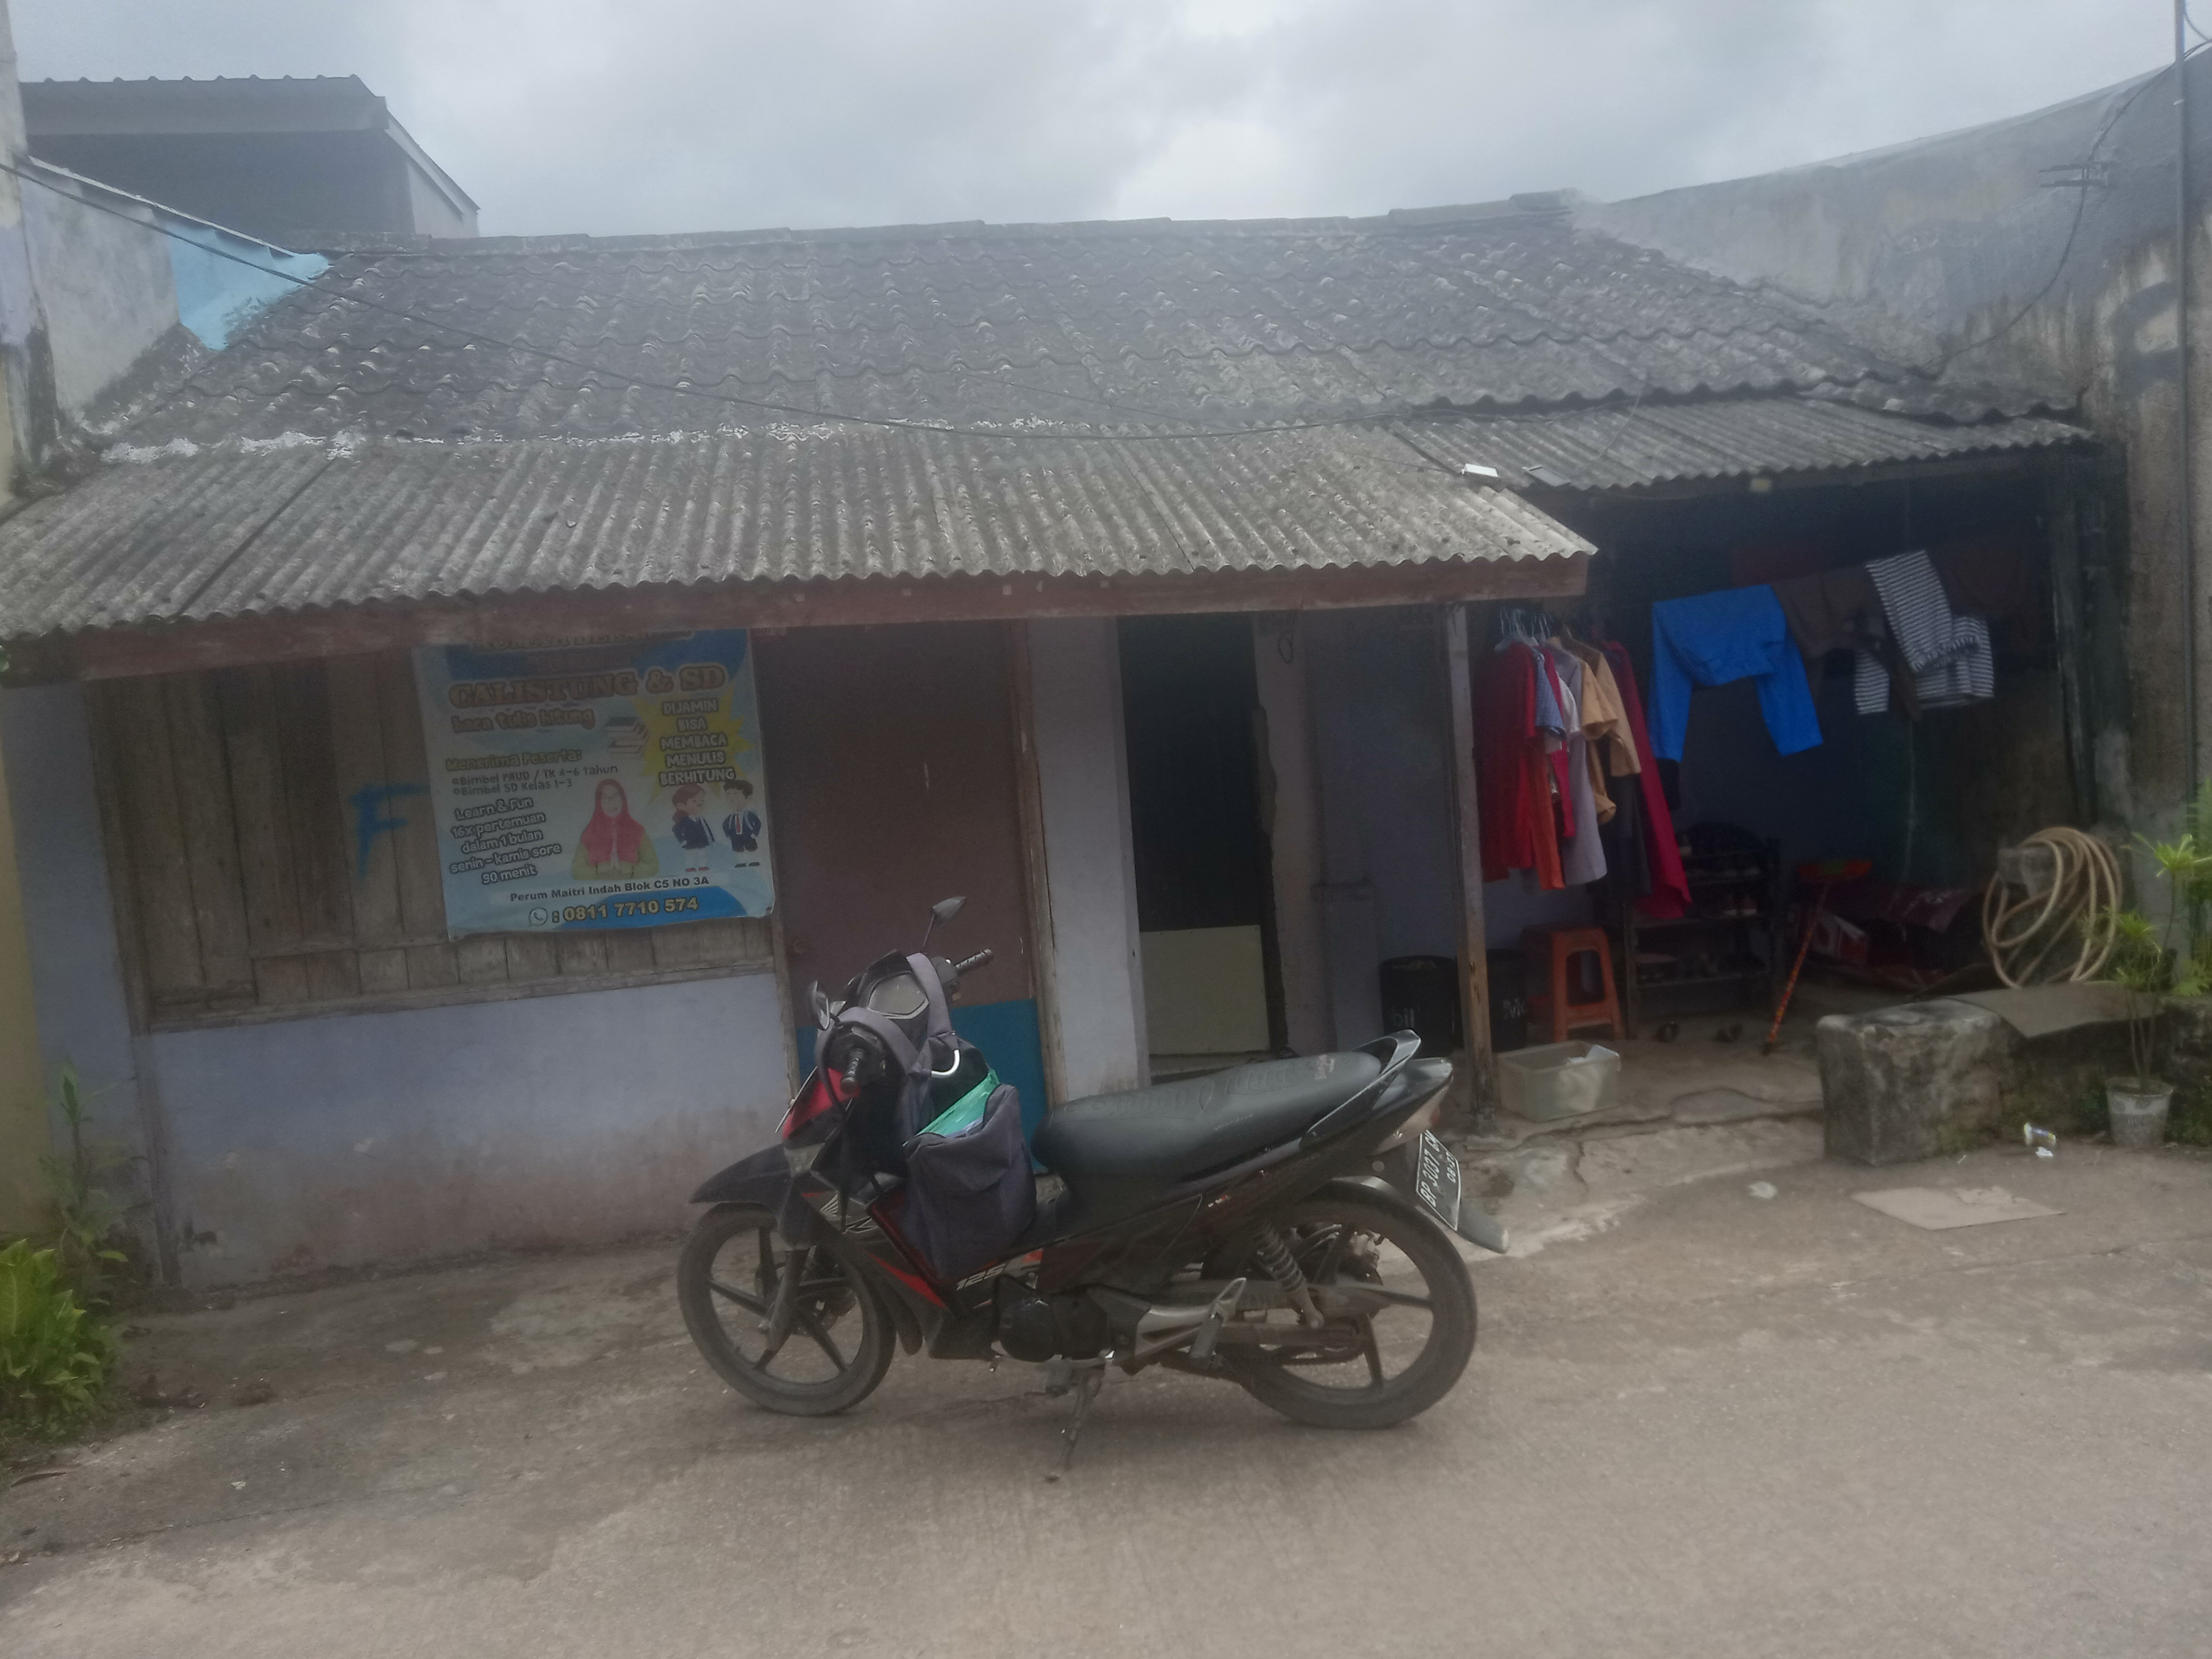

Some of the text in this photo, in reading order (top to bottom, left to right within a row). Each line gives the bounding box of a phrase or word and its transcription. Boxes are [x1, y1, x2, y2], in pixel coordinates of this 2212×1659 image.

[449, 665, 726, 708] CALISTUNG & SD
[663, 698, 718, 715] DIJAMIN
[677, 717, 707, 732] BISA
[660, 733, 728, 750] MEMBACA
[446, 749, 582, 771] Menerima Peserta:
[666, 750, 725, 767] MENULIS
[460, 774, 499, 785] Bimbel
[502, 771, 530, 782] PAUD
[543, 769, 556, 779] TK
[583, 765, 618, 776] tahun
[659, 767, 735, 786] BERHITUNG
[461, 783, 500, 796] Bimbel
[505, 782, 518, 793] SD
[522, 780, 551, 791] Kelas
[455, 797, 533, 820] Learn & Fun
[451, 812, 546, 839] 16x pertemuan
[462, 830, 543, 853] dalam 1 bulan
[449, 857, 484, 874] senin
[493, 848, 531, 865] kamis
[531, 843, 562, 858] sore
[482, 864, 538, 885] 90 menit
[510, 876, 709, 902] Perum Maitri Indah Blok C5 NO 3A
[563, 904, 607, 922] 0811
[614, 899, 659, 917] 7710
[664, 896, 699, 912] 574
[1420, 1181, 1436, 1208] BP
[956, 1263, 1006, 1292] 125
